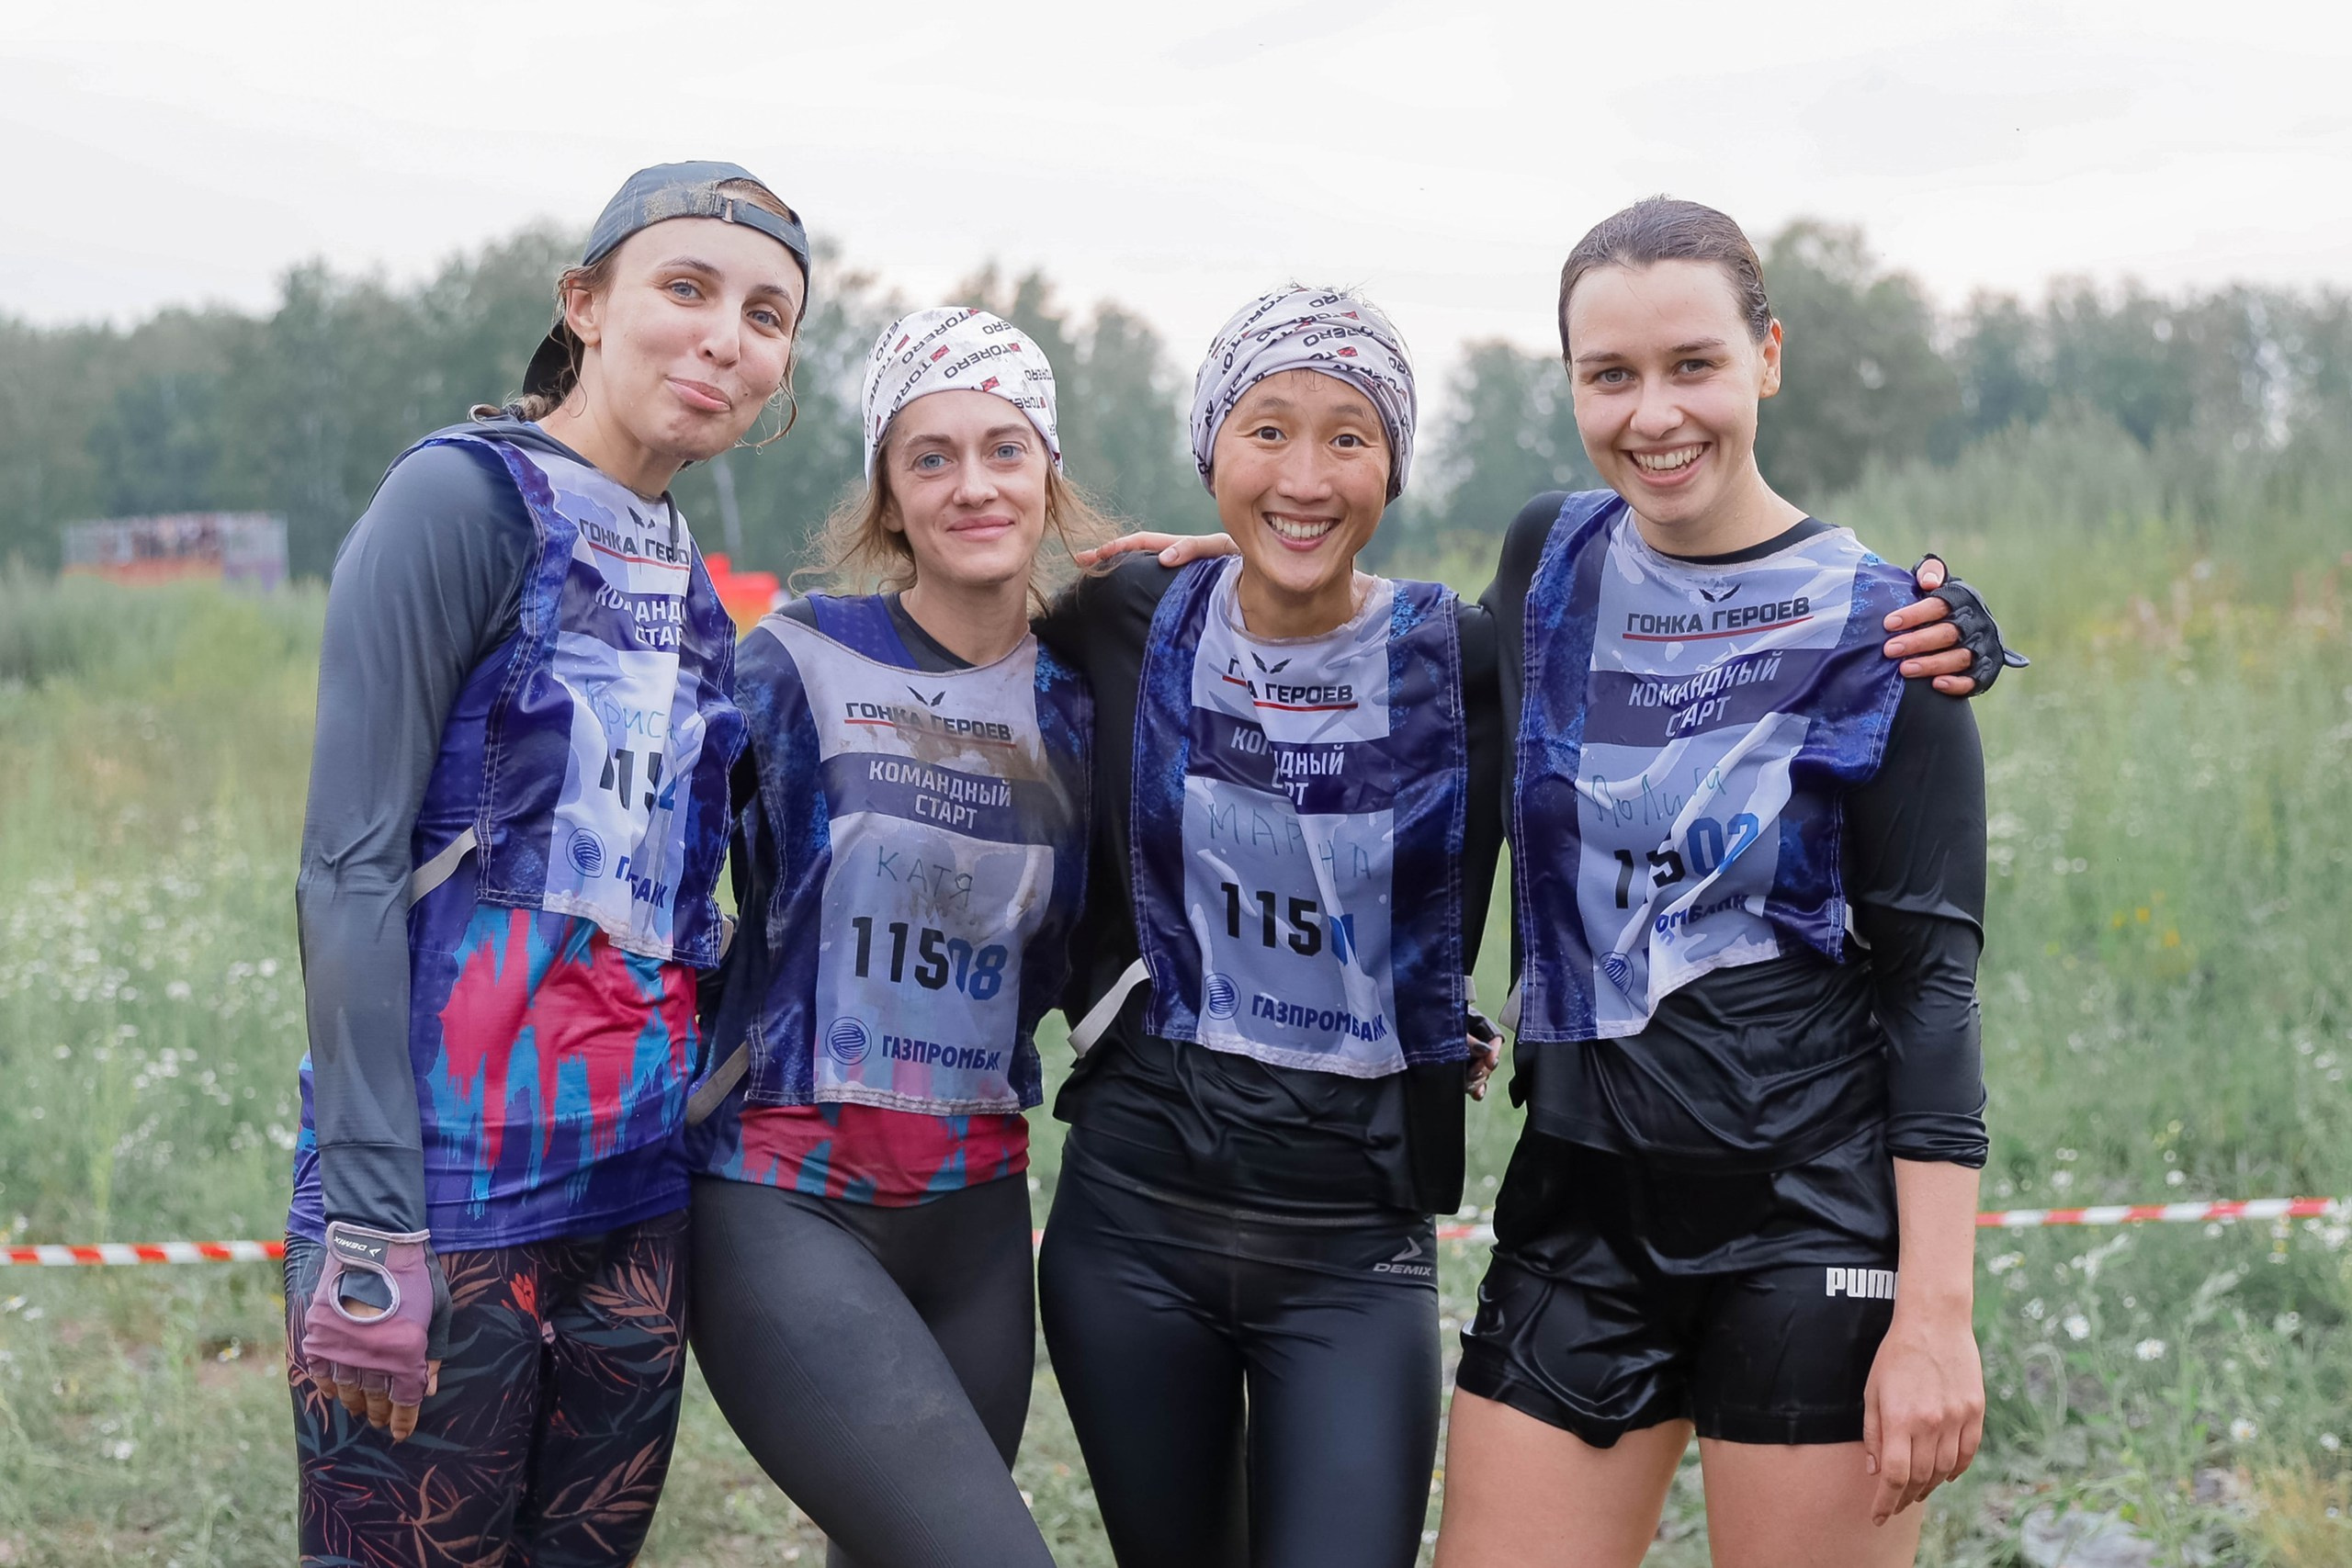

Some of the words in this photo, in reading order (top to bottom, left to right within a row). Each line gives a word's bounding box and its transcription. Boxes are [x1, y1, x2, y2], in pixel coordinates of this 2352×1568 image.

[901, 310, 969, 365] TORERO
[944, 344, 1011, 379] TORERO
[579, 517, 638, 556] ГОНКА
[1627, 612, 1702, 635] ГОНКА
[1712, 596, 1810, 630] ГЕРОЕВ
[1264, 682, 1353, 705] ГЕРОЕВ
[1628, 650, 1784, 707] КОМАНДНЫЙ
[845, 702, 922, 728] ГОНКА
[930, 716, 1012, 741] ГЕРОЕВ
[1665, 695, 1732, 738] СТАРТ
[868, 761, 1012, 807] КОМАНДНЫЙ
[914, 794, 978, 829] СТАРТ
[876, 845, 973, 907] КАТЯ
[334, 1235, 368, 1252] DEMIX
[1373, 1263, 1431, 1277] DEMIX
[1826, 1267, 1899, 1300] PUM
